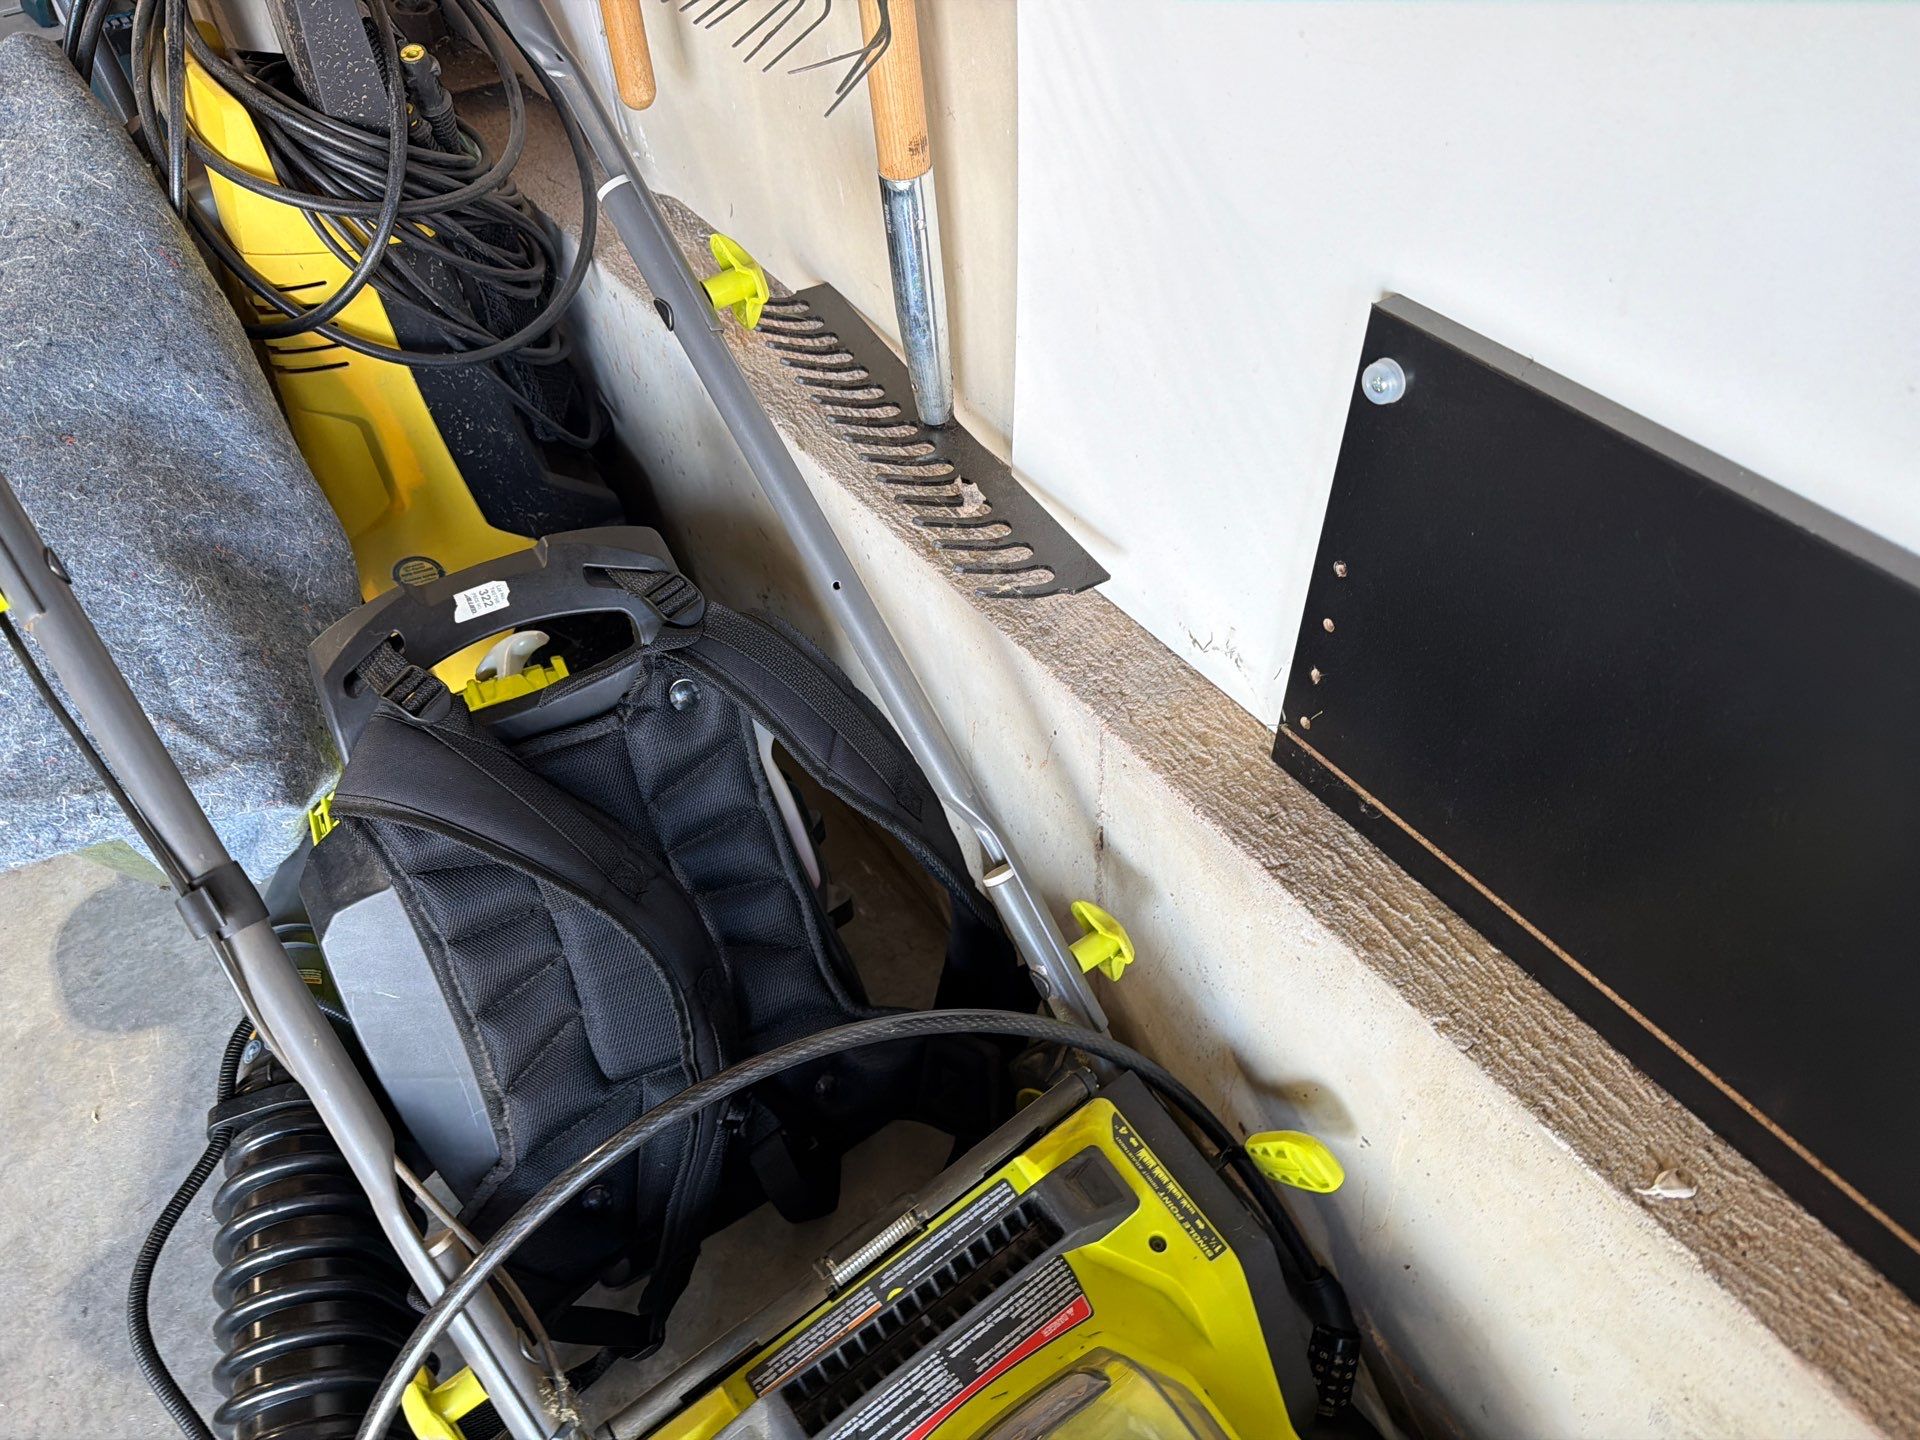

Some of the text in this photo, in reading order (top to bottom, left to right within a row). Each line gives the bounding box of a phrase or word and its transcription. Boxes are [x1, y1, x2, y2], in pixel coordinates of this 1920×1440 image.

[479, 589, 494, 608] 322
[1156, 1188, 1184, 1221] POINT
[1182, 1220, 1214, 1257] SINGLE
